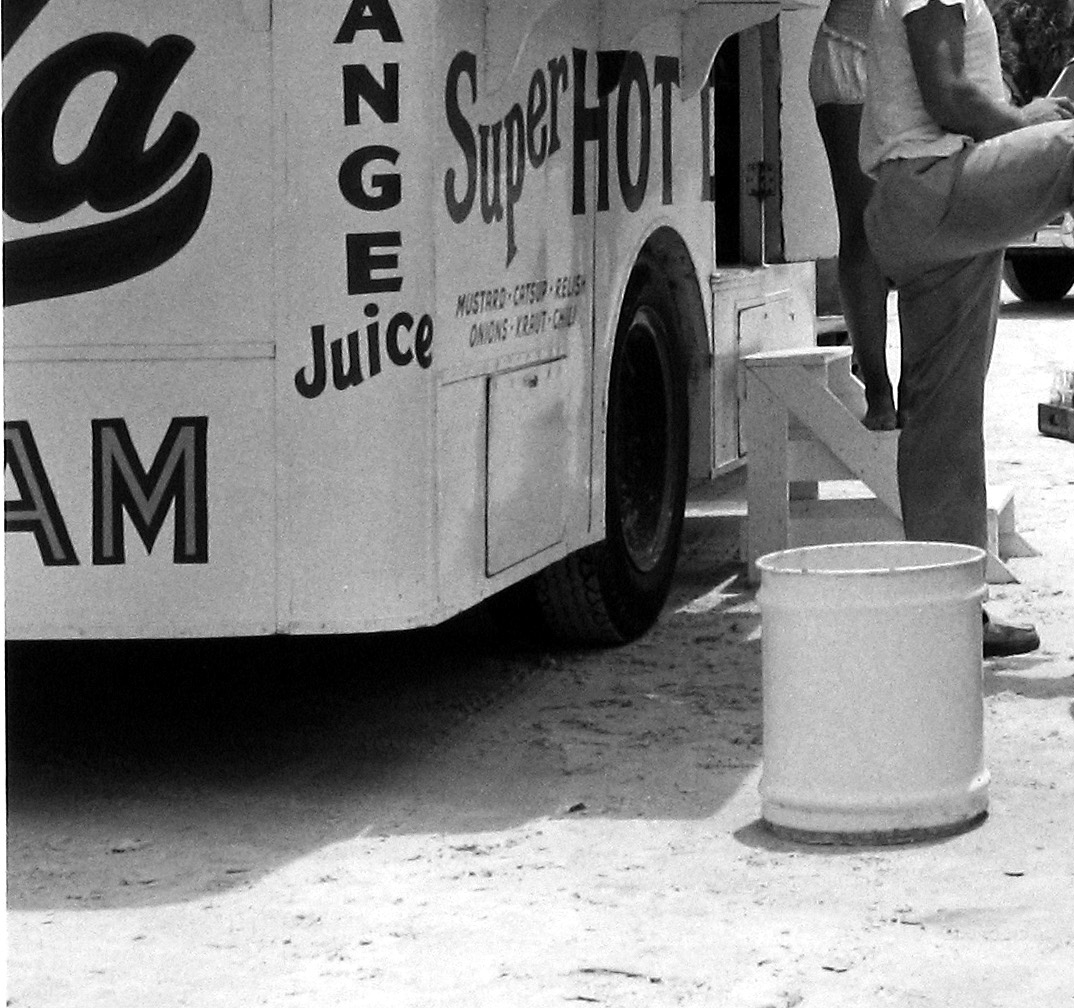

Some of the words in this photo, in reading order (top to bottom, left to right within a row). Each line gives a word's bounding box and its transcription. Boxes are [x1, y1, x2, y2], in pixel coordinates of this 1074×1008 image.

[444, 49, 569, 269] Super
[572, 47, 681, 216] HOT
[294, 302, 434, 400] Juice
[455, 286, 506, 318] MUSTARD
